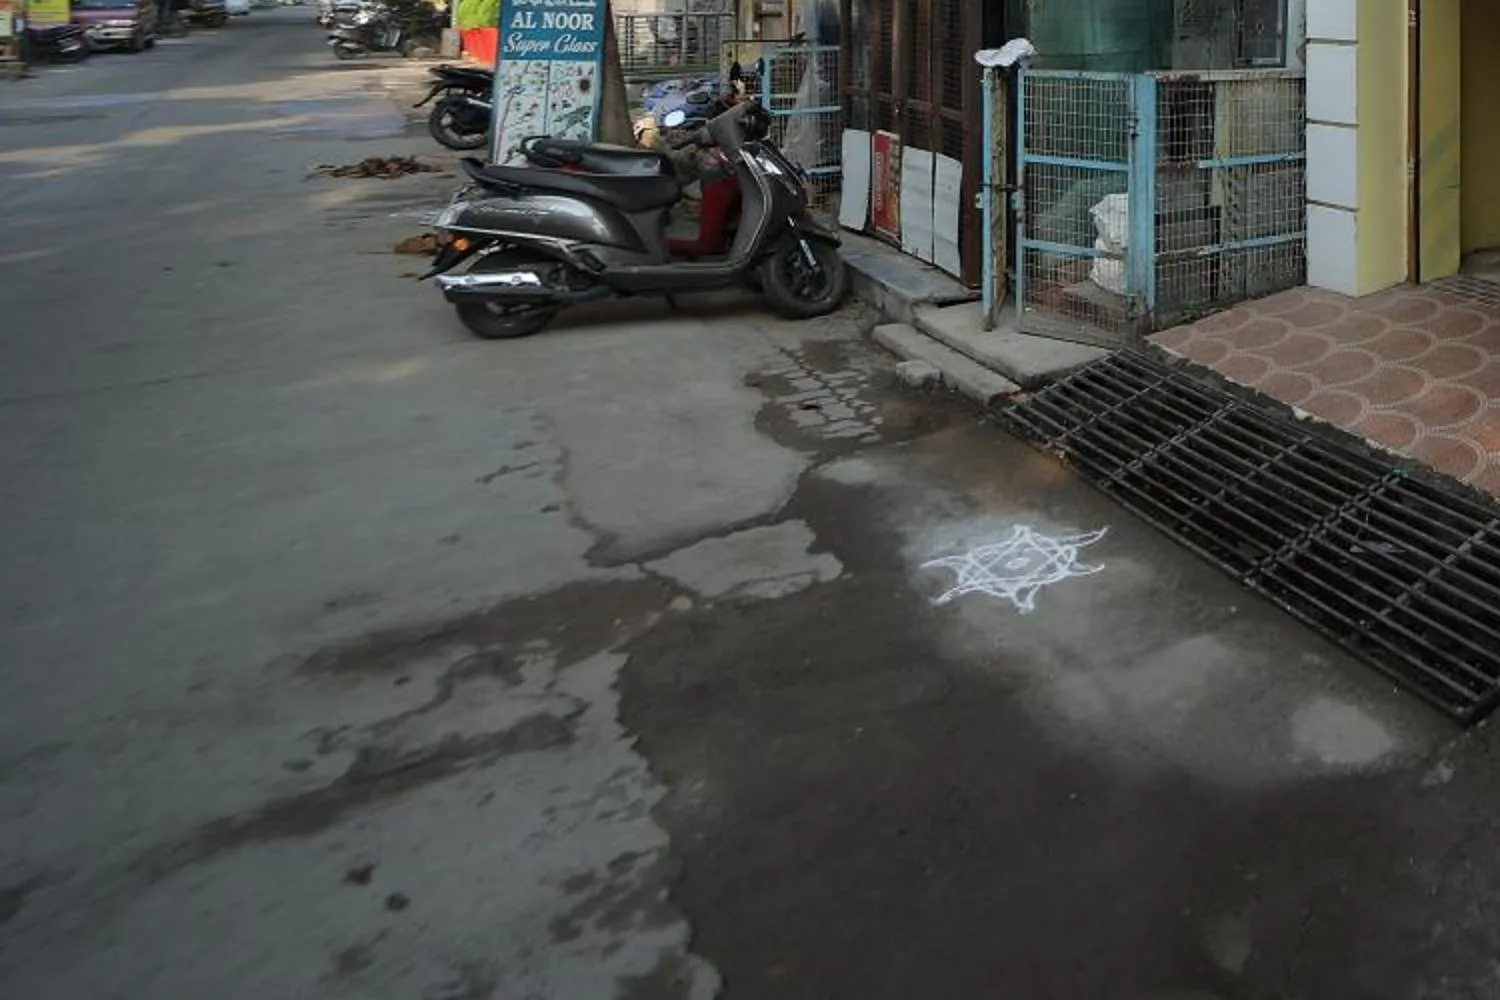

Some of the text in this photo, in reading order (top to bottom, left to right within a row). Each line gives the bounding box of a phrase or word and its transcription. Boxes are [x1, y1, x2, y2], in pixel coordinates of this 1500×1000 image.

[510, 11, 595, 31] AL NOOR
[503, 31, 599, 57] Super Glass
